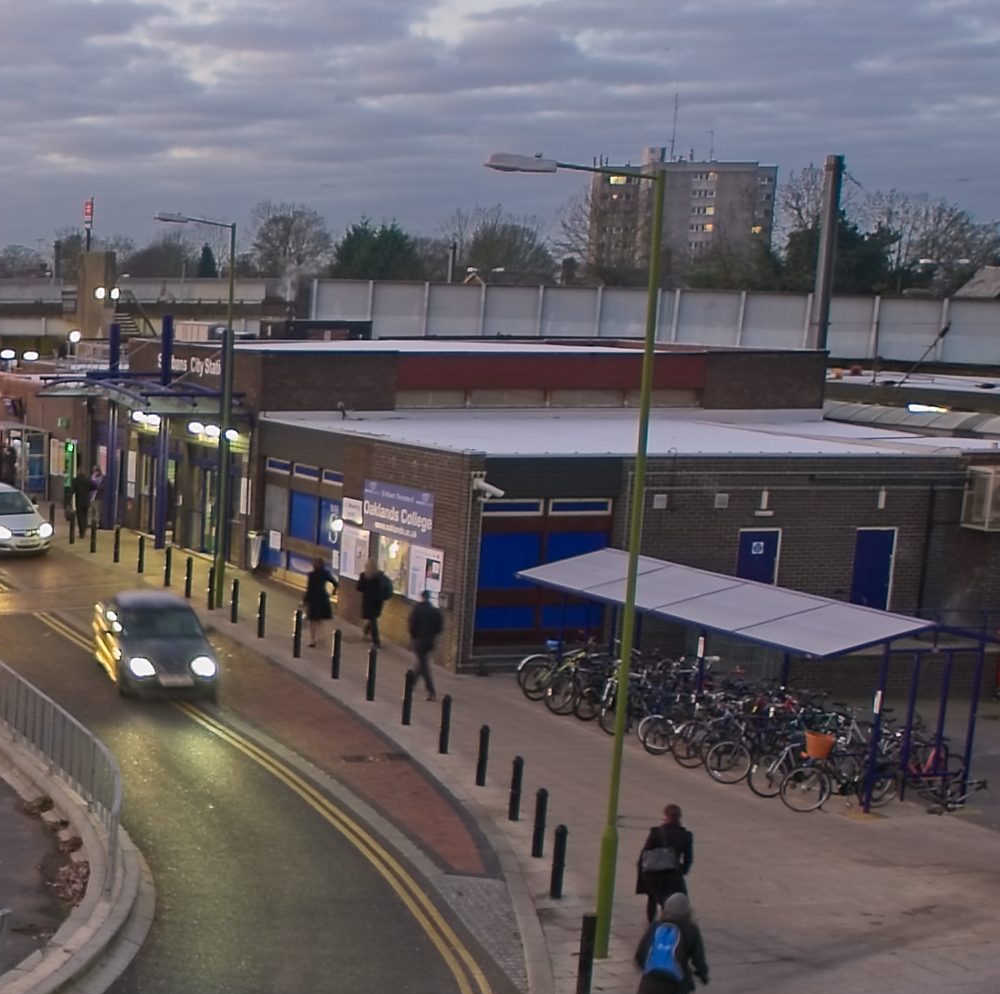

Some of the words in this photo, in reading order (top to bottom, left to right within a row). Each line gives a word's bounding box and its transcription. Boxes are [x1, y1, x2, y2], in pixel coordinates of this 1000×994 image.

[190, 356, 204, 377] City
[204, 357, 221, 375] Stati
[364, 500, 399, 522] Oaklands
[401, 509, 432, 532] College
